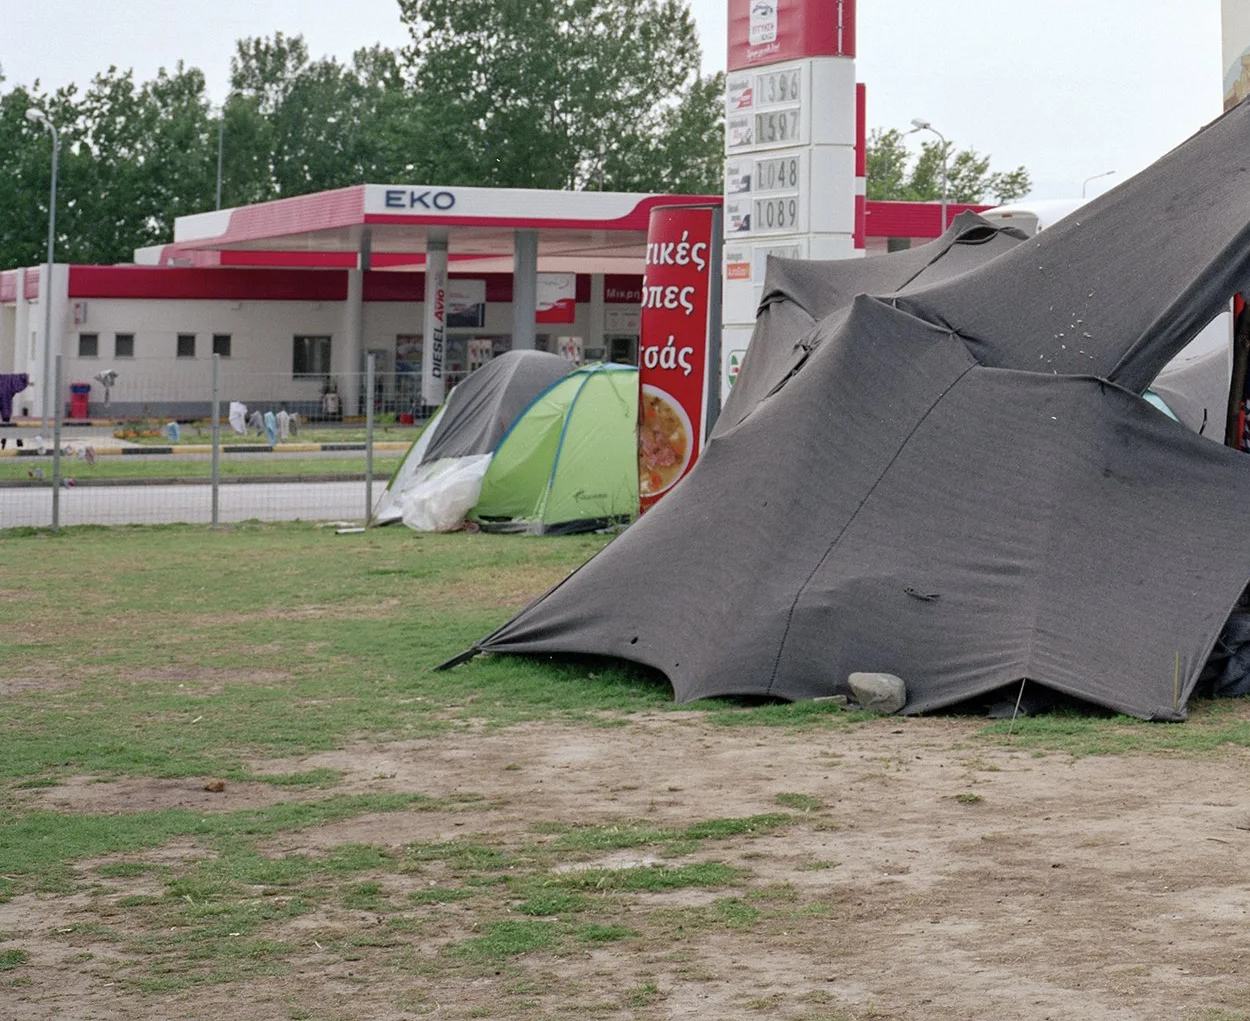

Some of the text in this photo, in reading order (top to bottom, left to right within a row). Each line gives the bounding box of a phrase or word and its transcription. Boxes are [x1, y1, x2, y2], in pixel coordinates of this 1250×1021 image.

[757, 159, 797, 189] 1048
[385, 190, 456, 210] EKO
[756, 199, 797, 229] 1089
[431, 326, 443, 379] DIESEL
[641, 335, 694, 377] σάς
